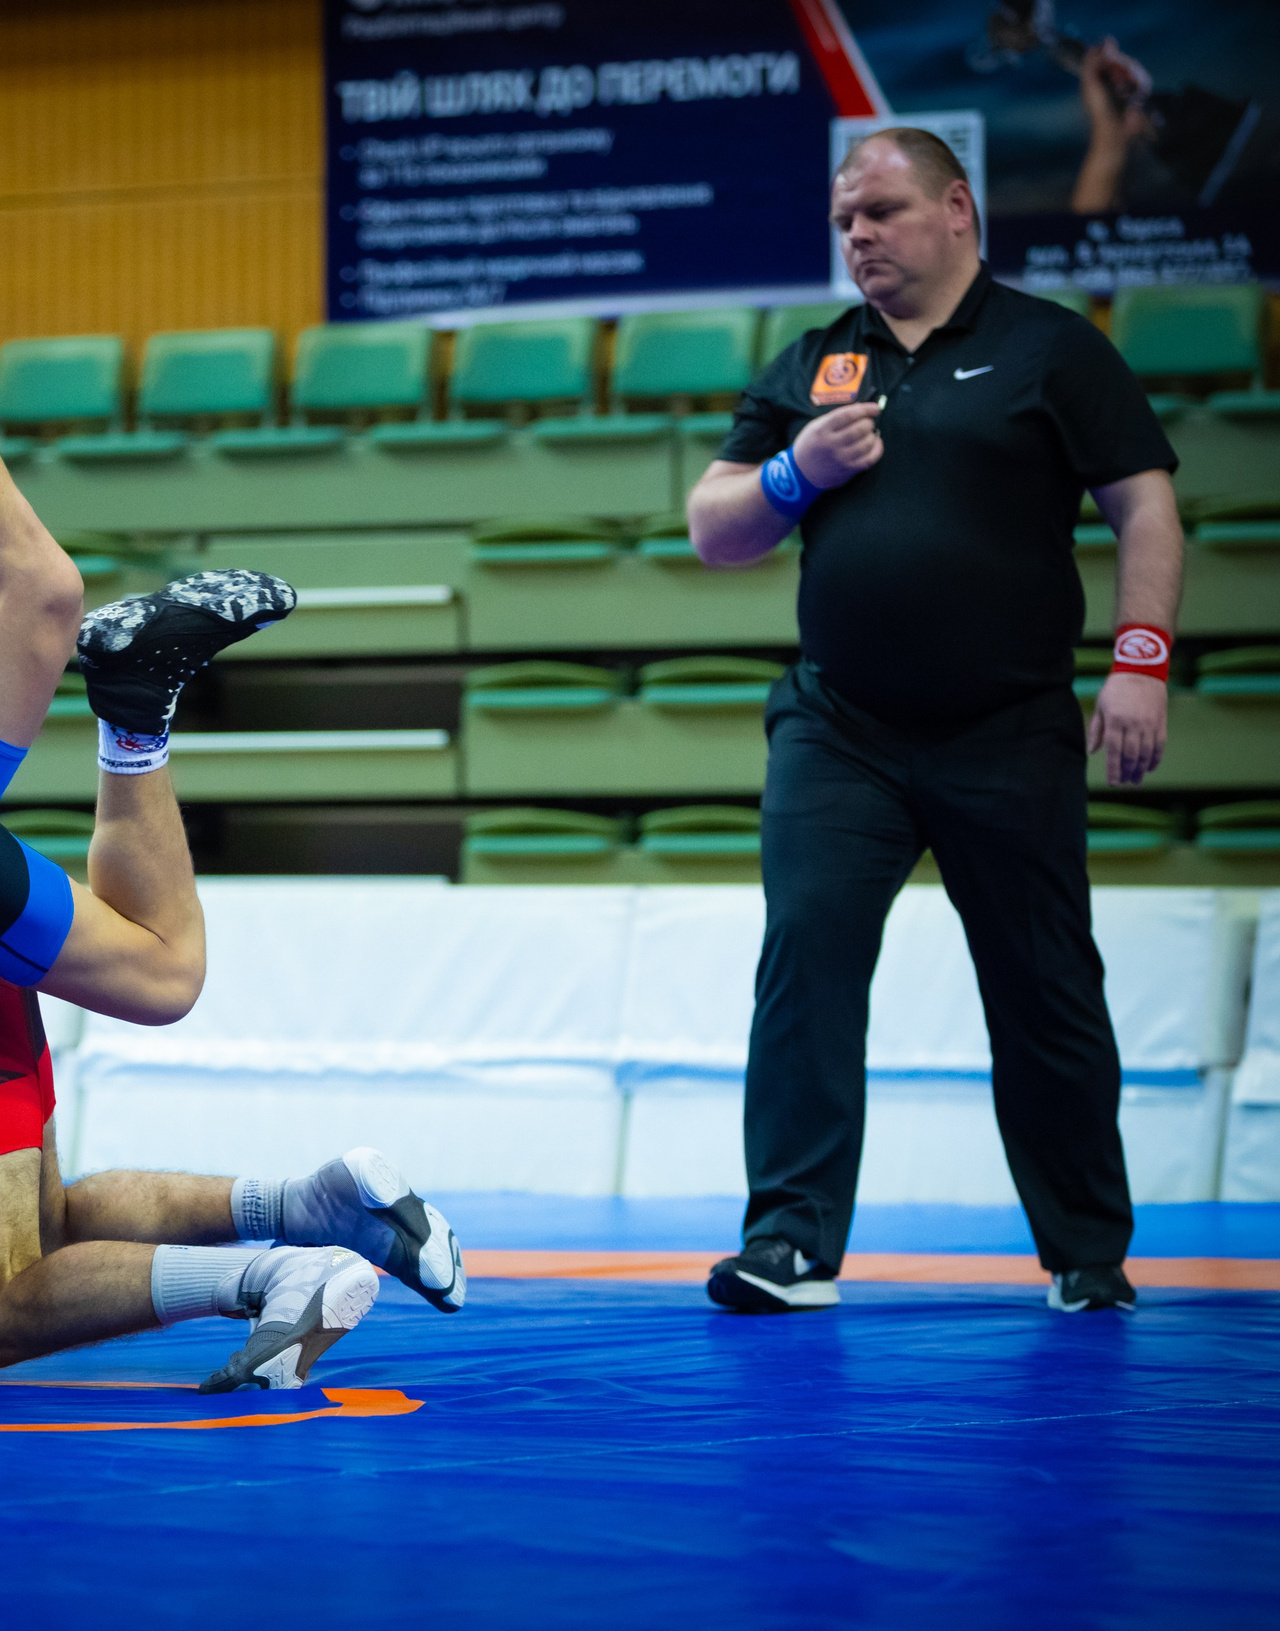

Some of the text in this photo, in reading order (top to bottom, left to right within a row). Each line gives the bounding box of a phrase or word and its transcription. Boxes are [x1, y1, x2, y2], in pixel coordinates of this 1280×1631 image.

[338, 52, 800, 122] ТВІЙ ШЛЯХ ДО ПЕРЕМОГИ
